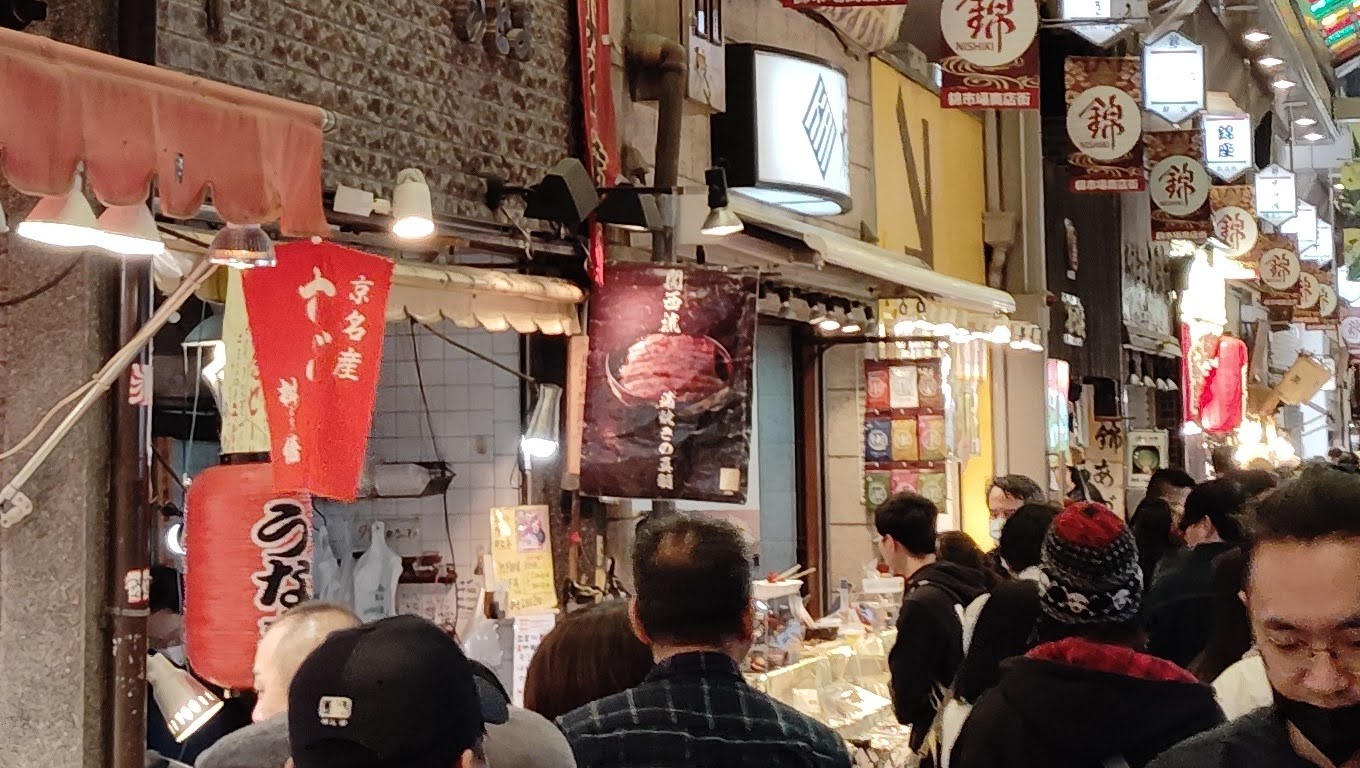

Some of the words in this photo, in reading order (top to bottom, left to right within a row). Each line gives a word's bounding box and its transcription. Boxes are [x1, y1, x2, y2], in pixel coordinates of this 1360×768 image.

[1078, 94, 1125, 151] 錦
[1158, 162, 1196, 207] 錦
[333, 274, 375, 382] 京名産
[256, 503, 310, 630] うな
